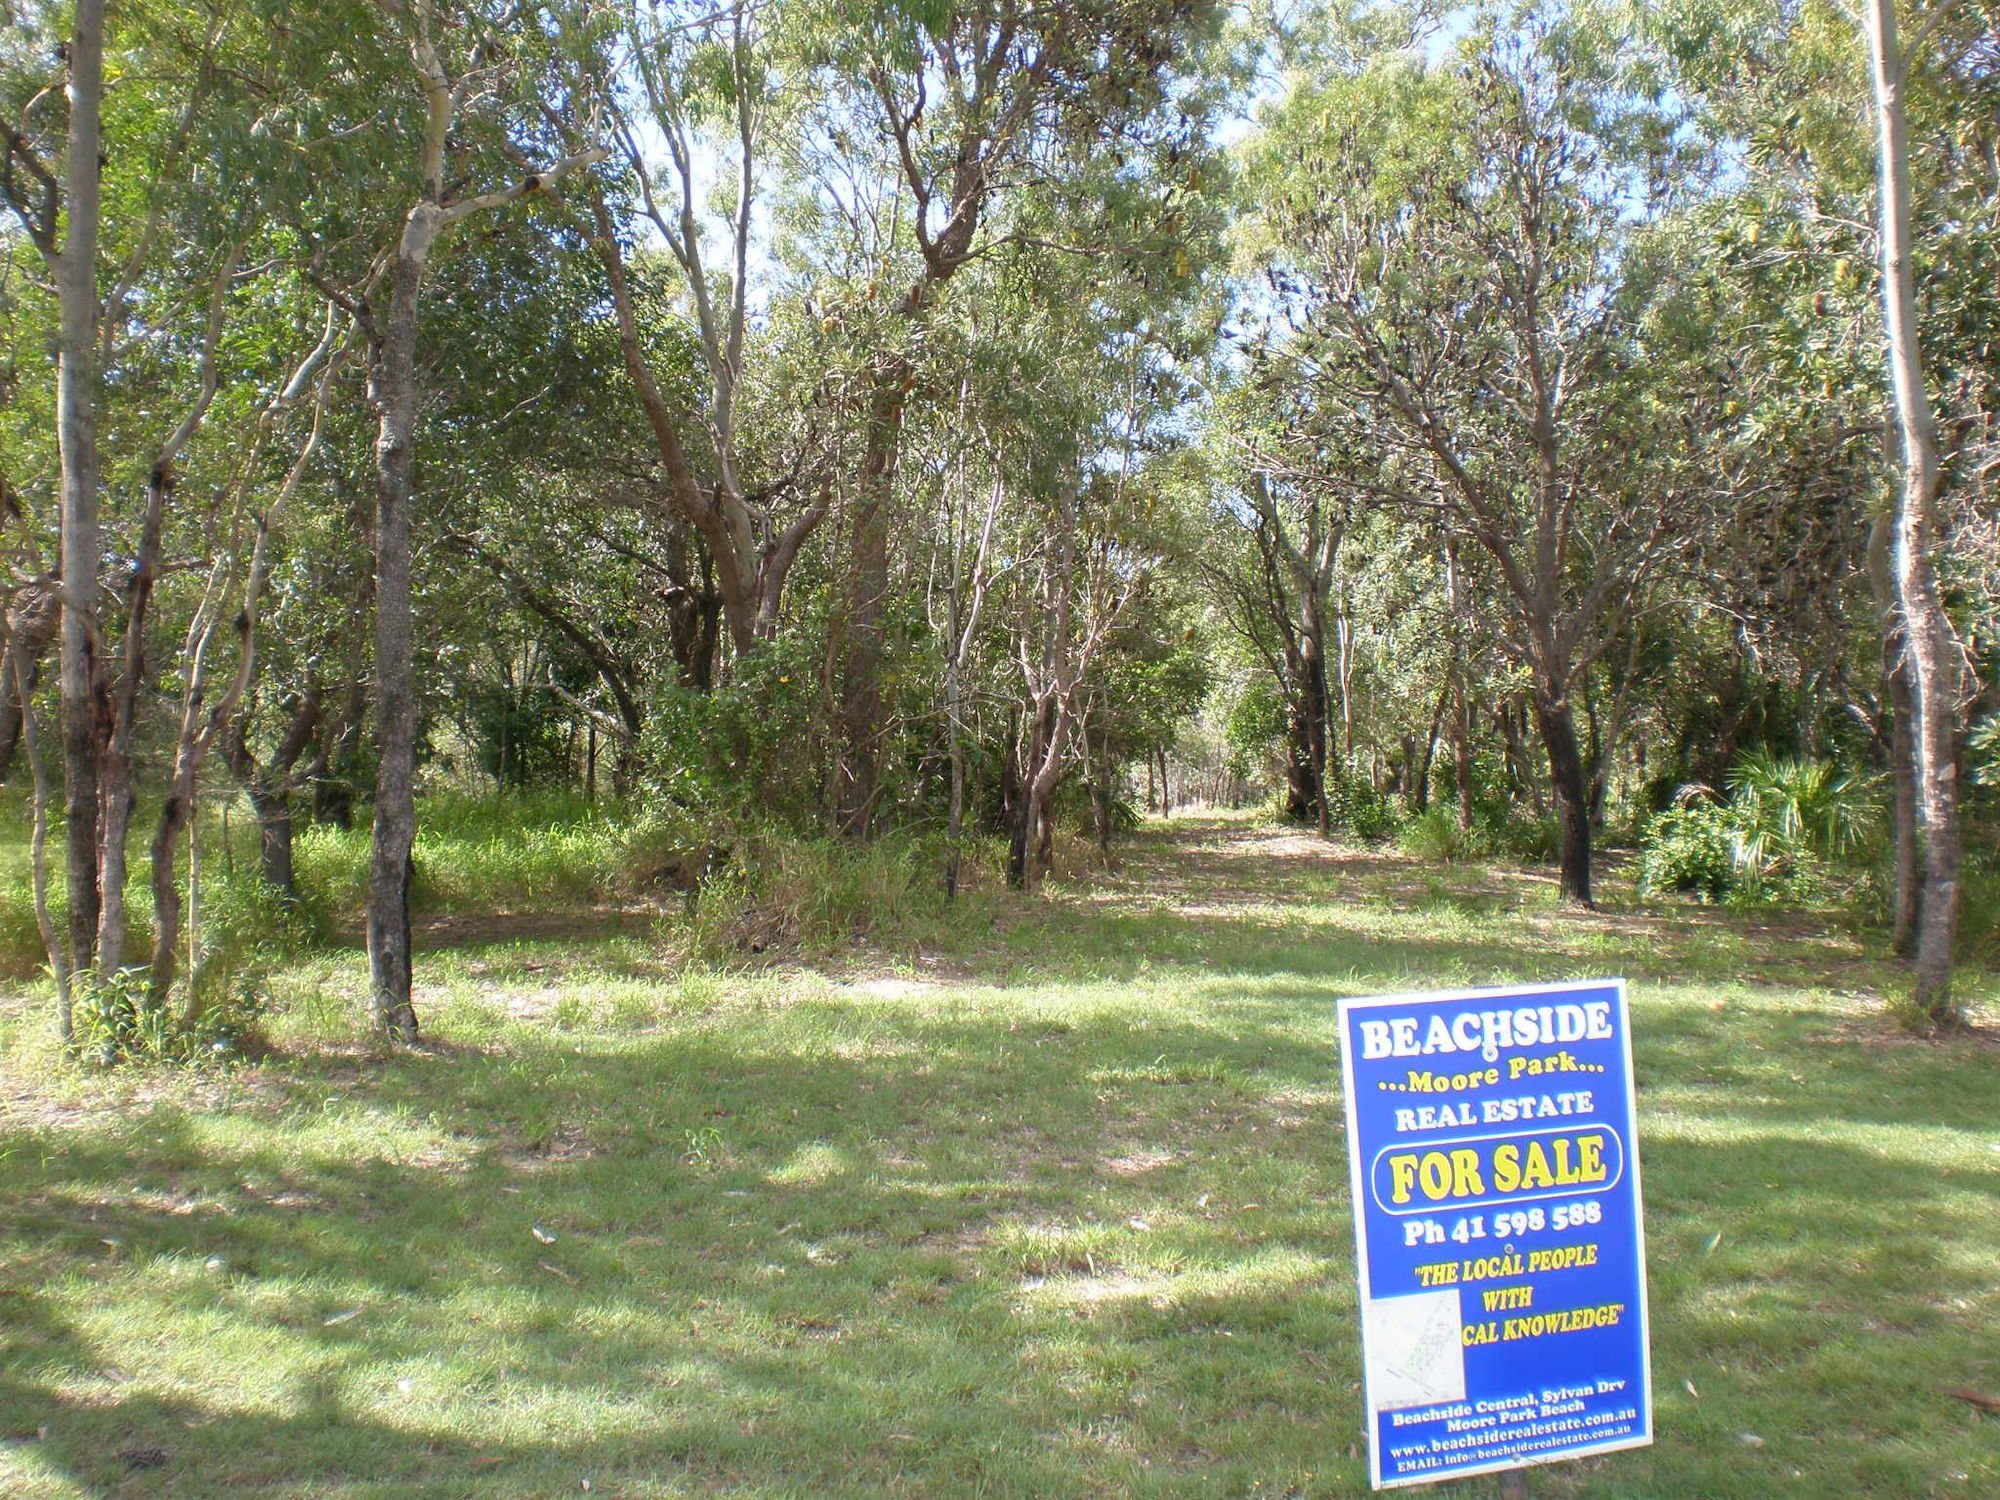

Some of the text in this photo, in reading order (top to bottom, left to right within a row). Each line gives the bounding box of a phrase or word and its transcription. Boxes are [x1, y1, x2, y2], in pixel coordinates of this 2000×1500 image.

[1360, 1001, 1613, 1060] BEACHSIDE
[1395, 1091, 1594, 1132] REAL ESTATE
[1389, 1135, 1607, 1203] FOR SALE
[1403, 1201, 1602, 1246] Ph 41 598 588
[1462, 1254, 1524, 1281] LOCAL
[1528, 1245, 1598, 1274] PEOPLE
[1482, 1287, 1533, 1311] WITH
[1462, 1324, 1499, 1346] CAL
[1392, 1404, 1472, 1427] Beachside
[1476, 1394, 1539, 1413] Central,
[1542, 1387, 1594, 1404] Sylvan
[1597, 1379, 1626, 1394] Drv
[1447, 1401, 1585, 1433] Moore Park Beach
[1390, 1409, 1636, 1459] www.beachsiderealestate.com.au
[1397, 1458, 1442, 1473] EMAIL:
